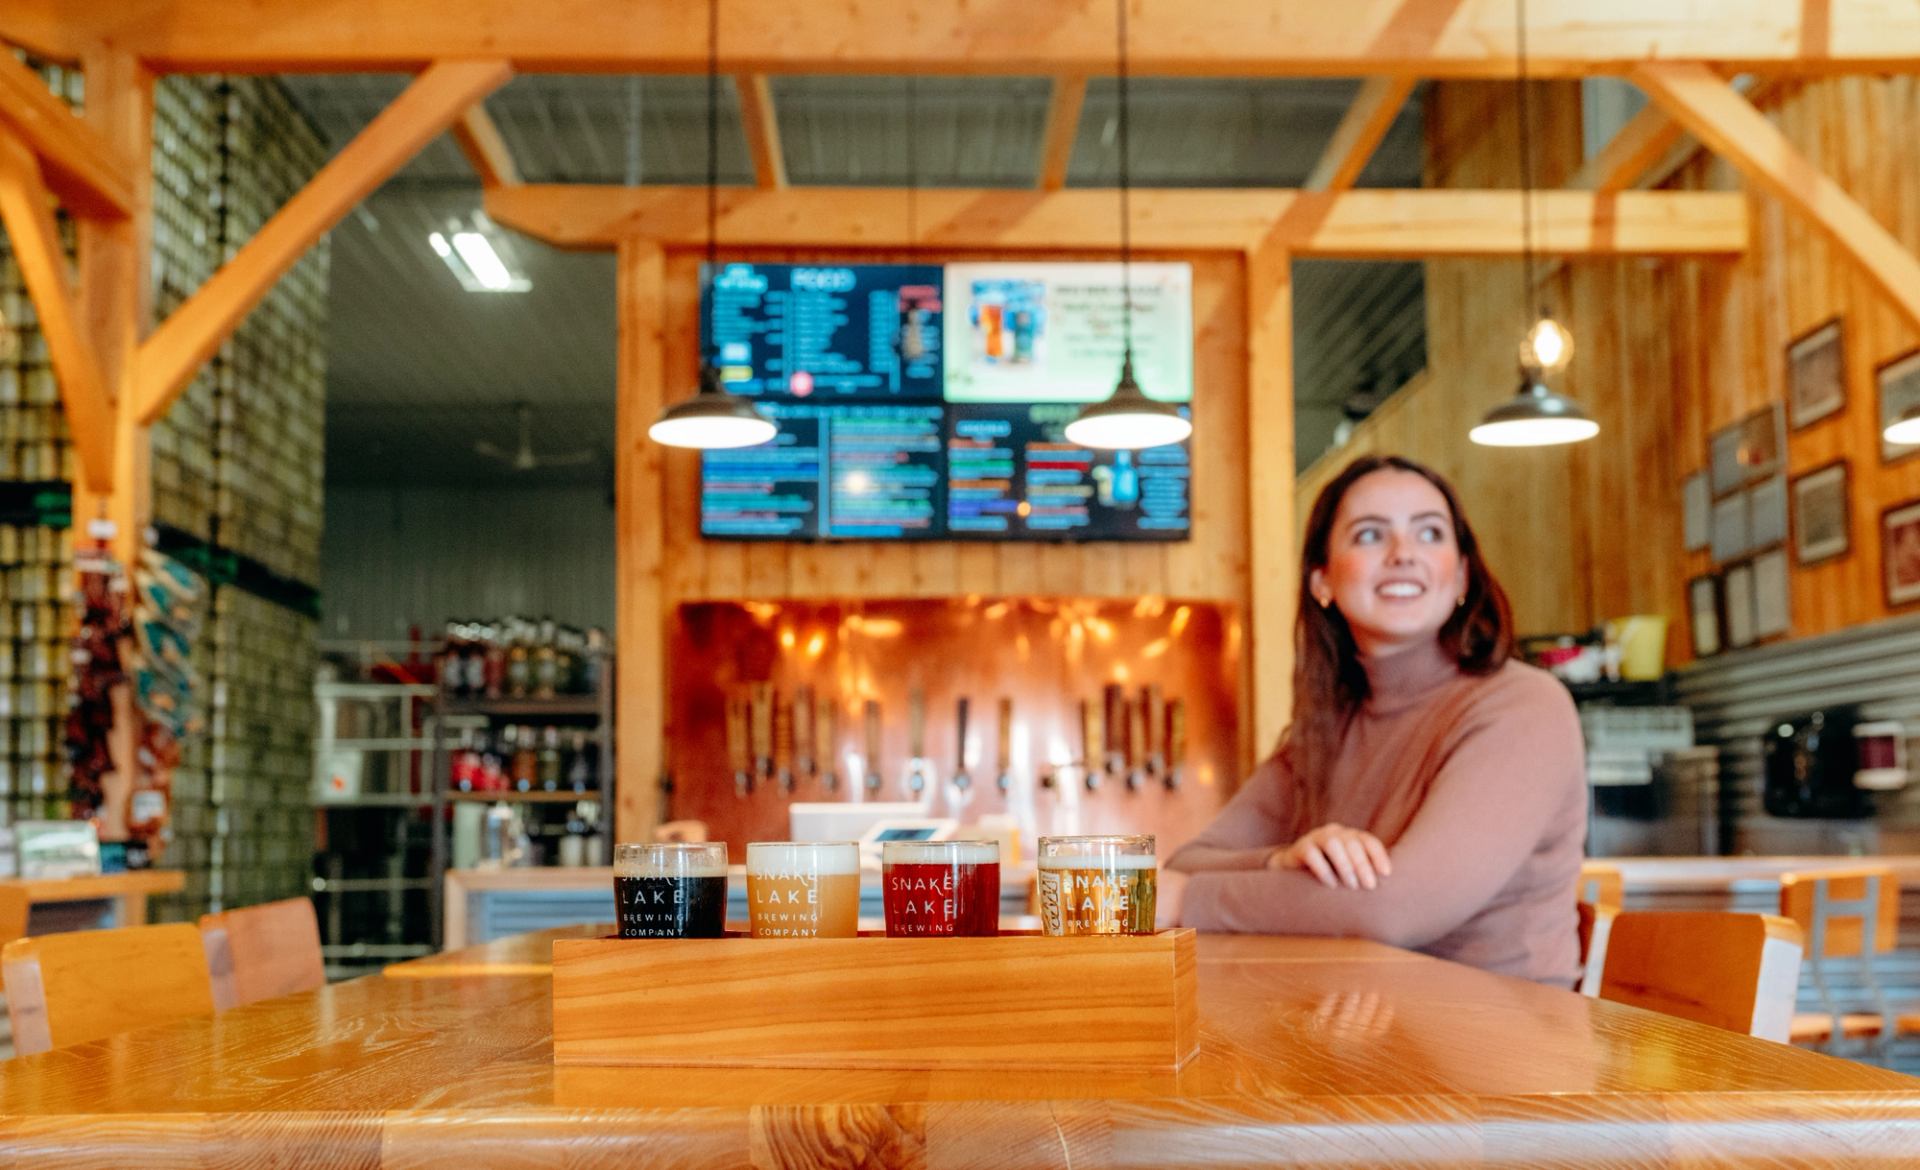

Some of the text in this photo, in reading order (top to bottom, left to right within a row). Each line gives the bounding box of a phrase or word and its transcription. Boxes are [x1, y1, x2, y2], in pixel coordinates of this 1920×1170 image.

[892, 877, 953, 896] SNAKE
[622, 890, 685, 904] LAKE
[756, 890, 818, 904] LAKE
[893, 899, 953, 914] LAKE
[623, 914, 684, 924] BREWING
[757, 913, 818, 924] BREWING
[625, 928, 684, 936] COMPANY
[759, 928, 817, 936] COMPANY
[894, 924, 954, 935] BREWING
